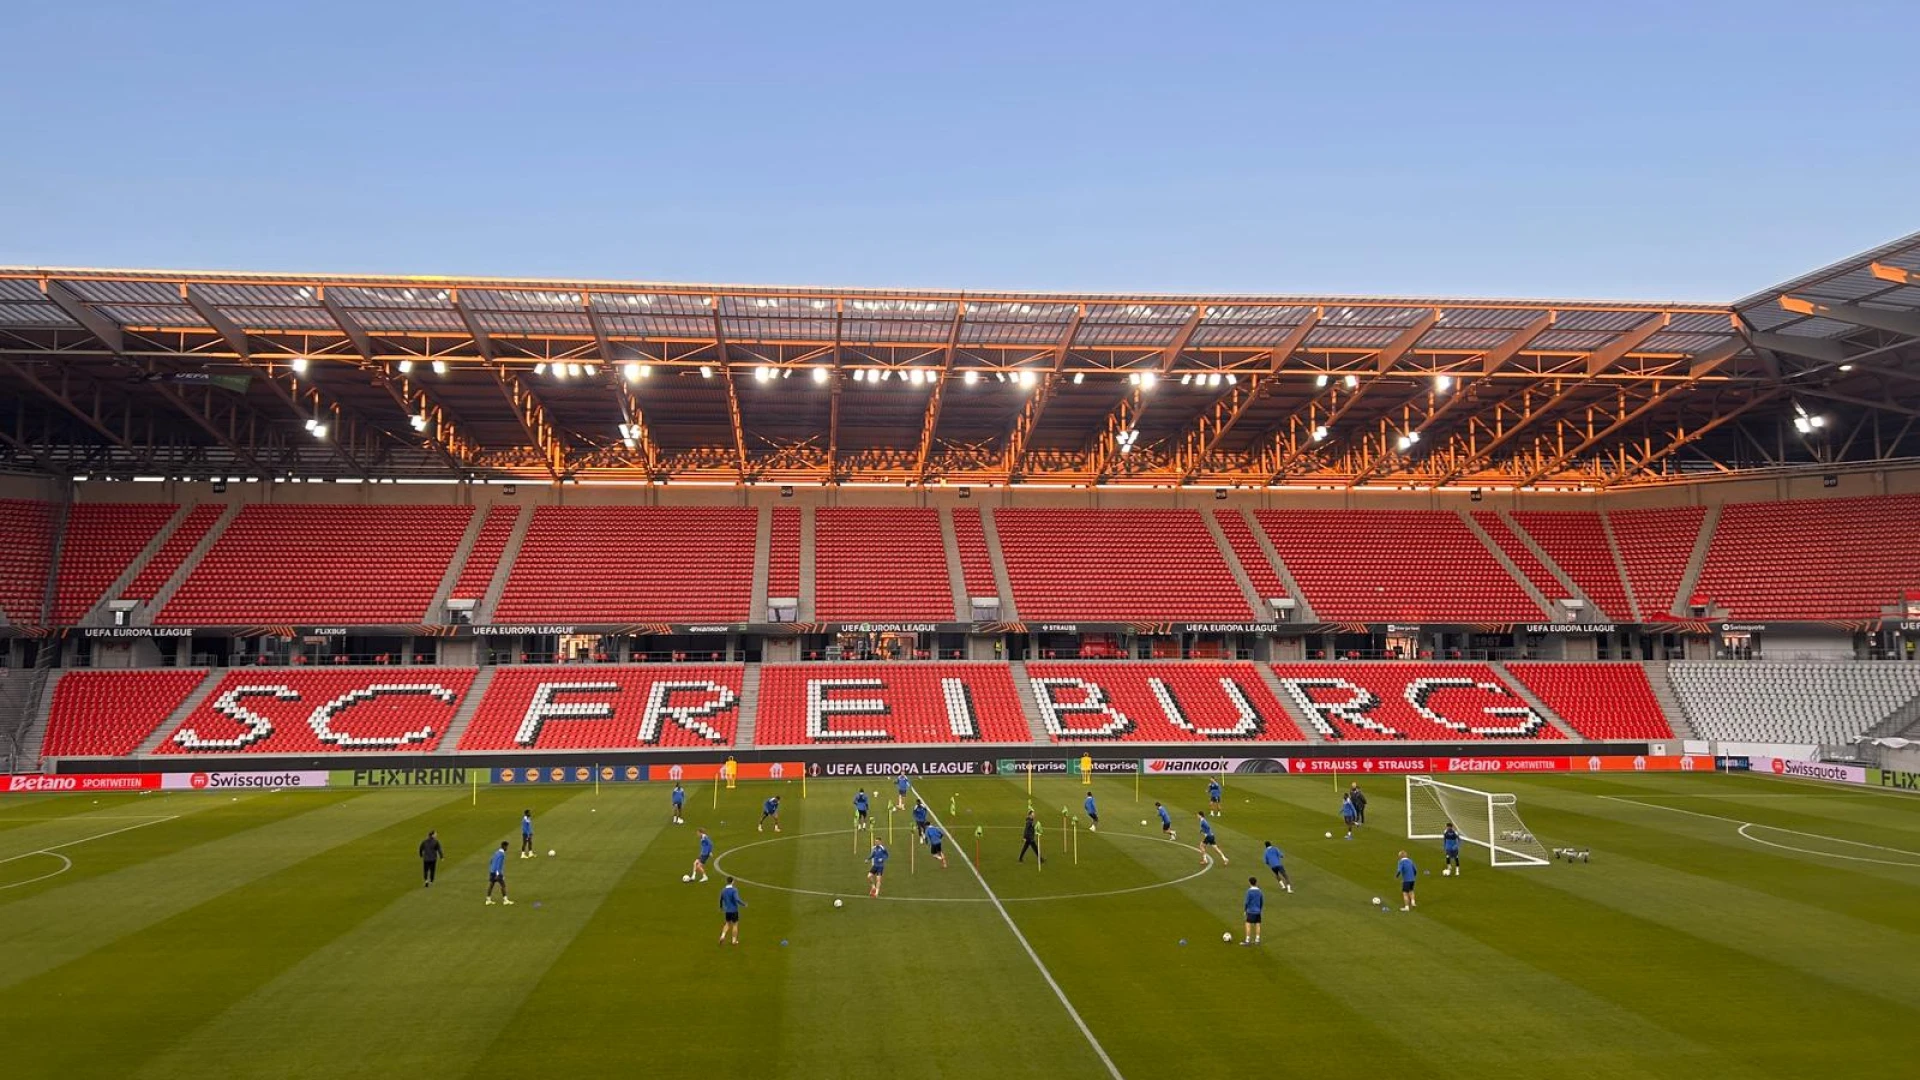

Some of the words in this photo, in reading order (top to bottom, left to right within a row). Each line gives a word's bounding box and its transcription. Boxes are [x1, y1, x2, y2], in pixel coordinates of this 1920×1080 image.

[85, 628, 111, 637] UEFA
[113, 628, 152, 637] EUROPA
[154, 628, 193, 637] LEAGUE
[473, 626, 498, 635] UEFA
[499, 626, 536, 635] EUROPA
[537, 626, 574, 635] LEAGUE
[841, 624, 864, 632] UEFA
[867, 624, 901, 632] EUROPA
[902, 624, 936, 632] LEAGUE
[1186, 624, 1209, 632] UEFA
[1211, 624, 1243, 632] EUROPA
[1245, 624, 1278, 632] LEAGUE
[1526, 624, 1549, 632] UEFA
[1550, 624, 1582, 632] EUROPA
[1583, 624, 1615, 632] LEAGUE
[172, 683, 456, 750] SC
[514, 676, 1545, 746] FREIBURG
[827, 763, 862, 775] UEFA
[866, 762, 919, 775] EUROPA
[922, 761, 974, 774] LEAGUE
[1089, 760, 1139, 772] terprise
[1163, 760, 1228, 772] HANKOOK
[1311, 760, 1358, 770] STRAUSS
[1378, 760, 1424, 770] STRAUSS
[1448, 758, 1501, 771] Betano
[1505, 760, 1555, 770] SPORTWETTEN
[1785, 759, 1847, 780] Swissquote
[9, 775, 77, 791] Betano
[81, 776, 142, 788] SPORTWETTEN
[210, 772, 301, 788] Swissquote
